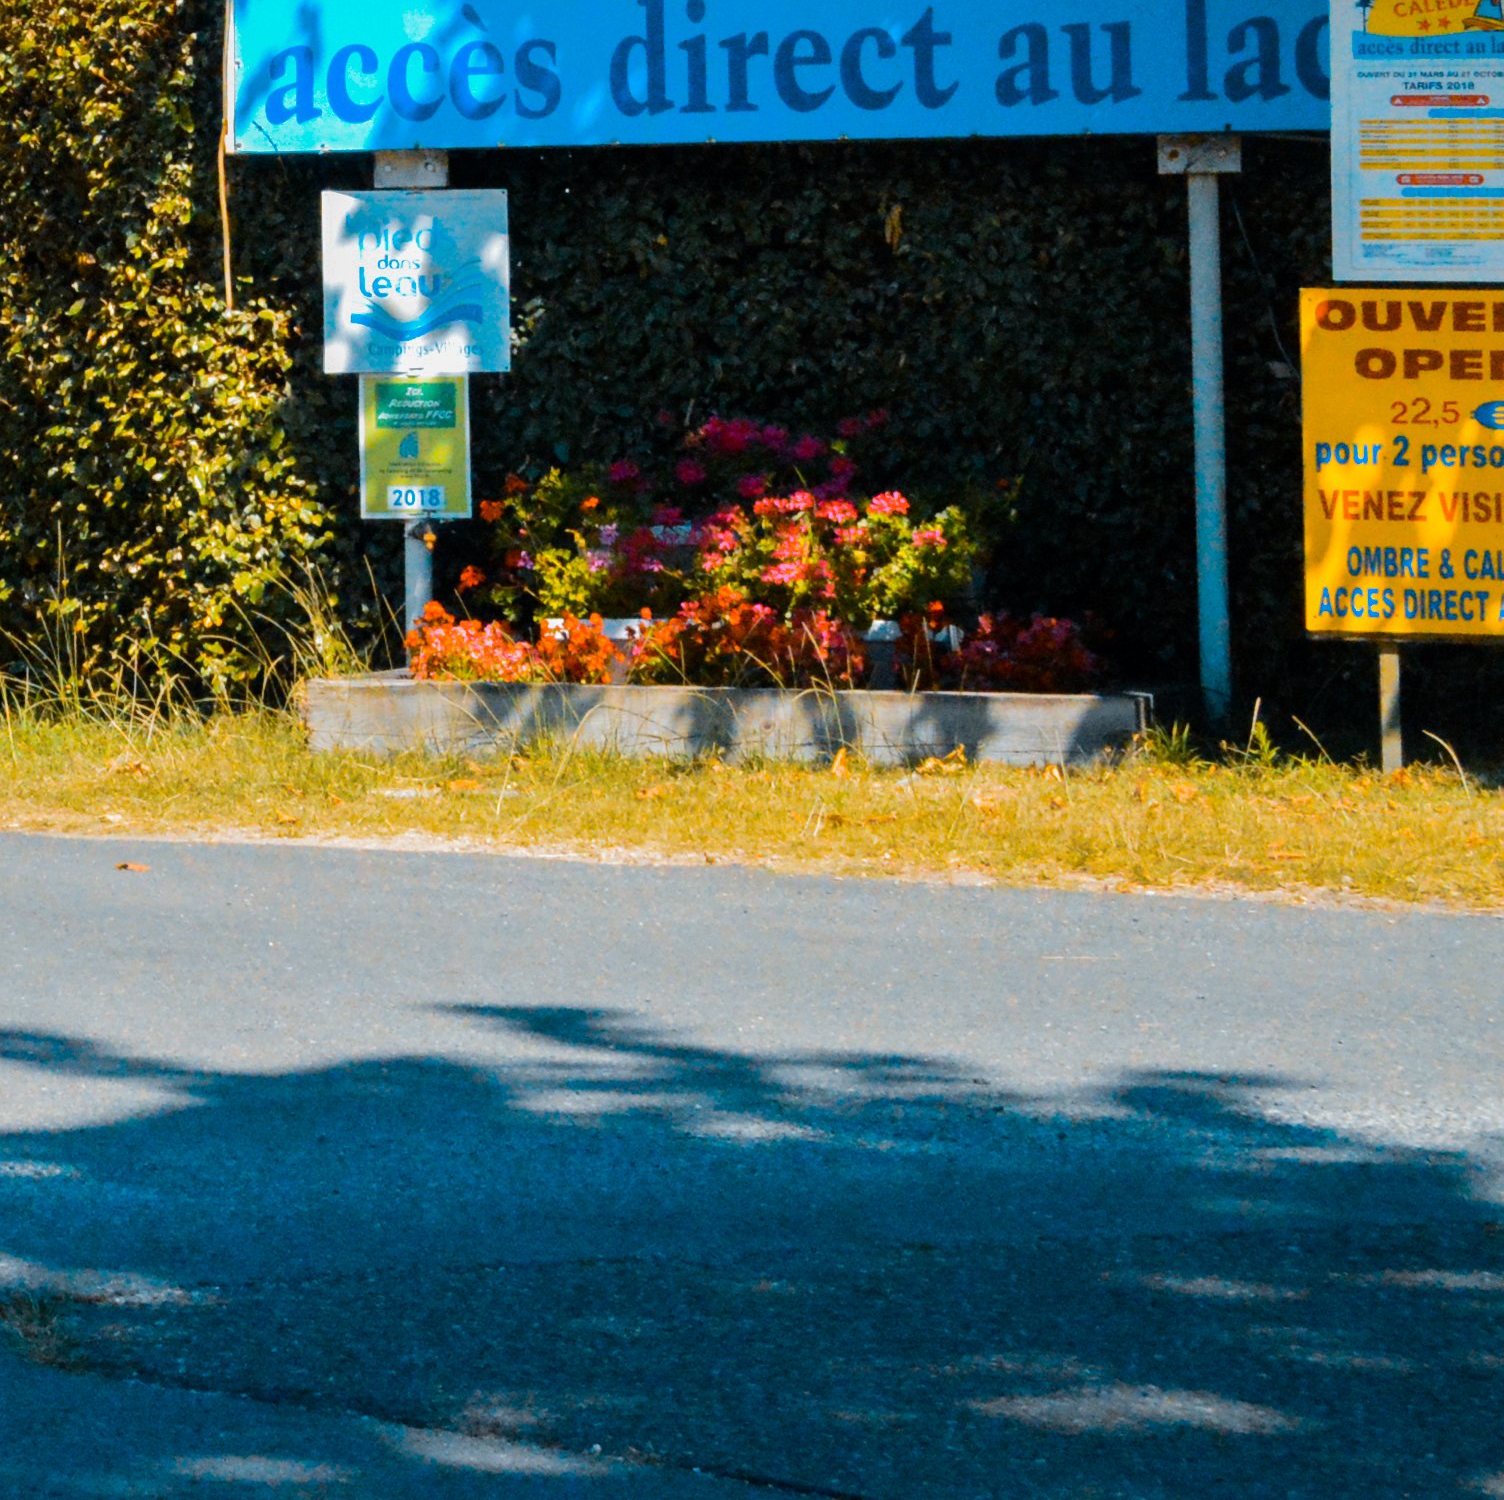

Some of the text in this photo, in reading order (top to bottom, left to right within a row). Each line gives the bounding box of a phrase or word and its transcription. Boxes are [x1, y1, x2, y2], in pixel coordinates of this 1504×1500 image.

[1358, 37, 1404, 55] accès
[1410, 36, 1459, 54] direct
[265, 3, 562, 126] accès
[995, 20, 1142, 108] au
[1403, 81, 1475, 91] TARIFS 2018
[1315, 435, 1504, 474] pour 2 perso
[392, 489, 441, 507] 2018
[1318, 489, 1503, 523] VENEZ VISI
[1347, 545, 1504, 580] OMBRE & CAL
[1318, 586, 1395, 618] ACCES
[1404, 588, 1489, 621] DIRECT
